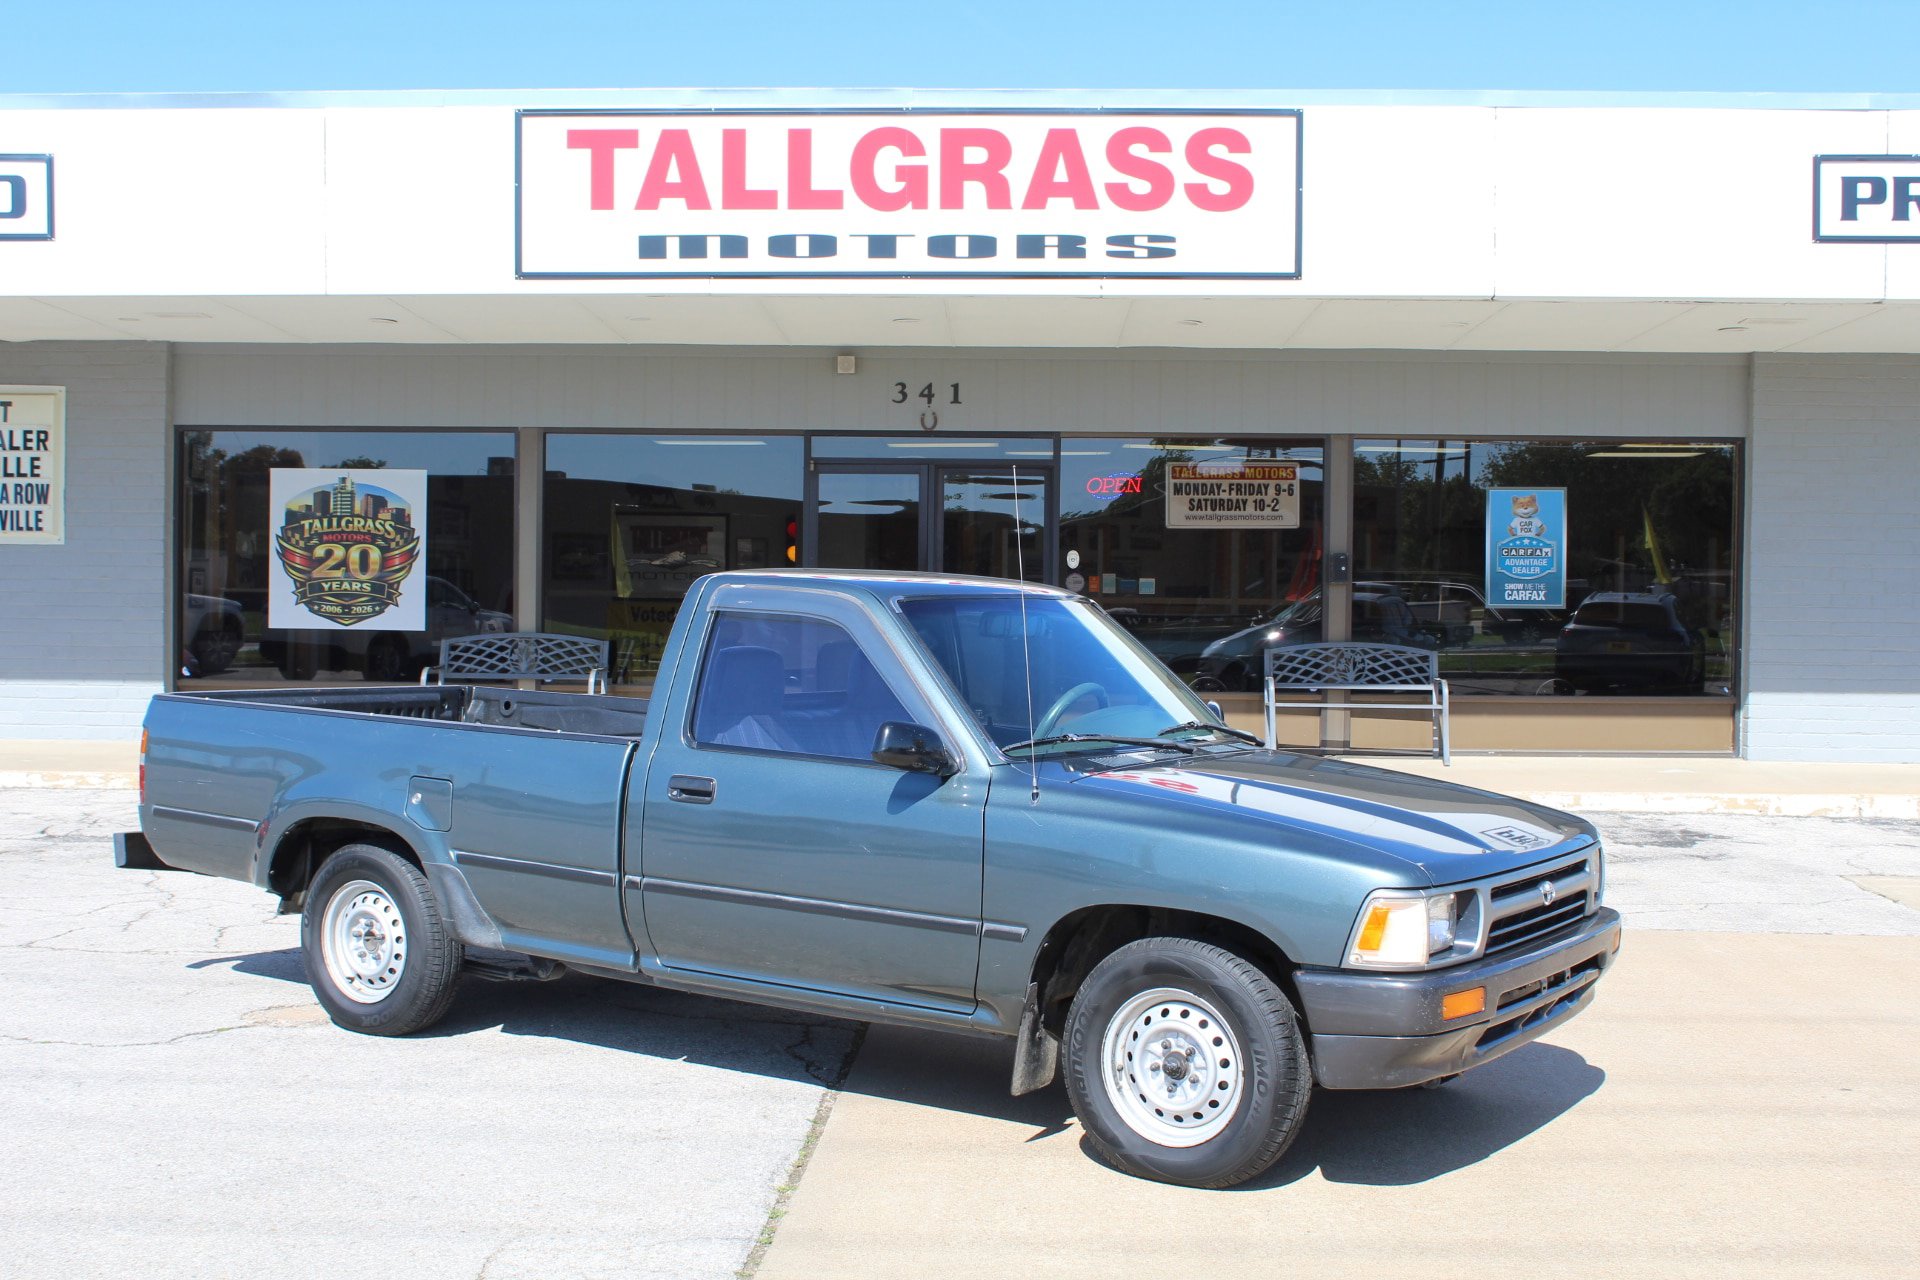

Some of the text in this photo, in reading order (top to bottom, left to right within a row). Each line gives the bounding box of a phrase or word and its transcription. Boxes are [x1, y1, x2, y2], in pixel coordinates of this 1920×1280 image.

[567, 126, 1255, 212] TALLGRASS
[891, 381, 963, 405] 341
[1174, 466, 1294, 479] TALLGRASS MOTORS
[1086, 477, 1143, 493] OPEN
[1274, 483, 1295, 497] 9-6
[0, 483, 50, 504] A ROW
[1188, 498, 1280, 512] SATURDAY 10-2
[0, 510, 44, 531] VILLE
[1184, 514, 1283, 523] www.tallgrassmotors.com
[300, 516, 396, 539] TALLGRASS
[323, 533, 372, 543] MOTORS
[1502, 548, 1551, 557] CARFAX
[311, 543, 382, 580] 20
[1504, 558, 1548, 566] ADVANTAGE
[1512, 566, 1541, 574] DEALER
[321, 581, 372, 592] YEARS
[1504, 590, 1547, 601] CARFAX
[320, 604, 343, 613] 2006
[351, 605, 373, 614] 2026
[630, 606, 677, 622] Voted
